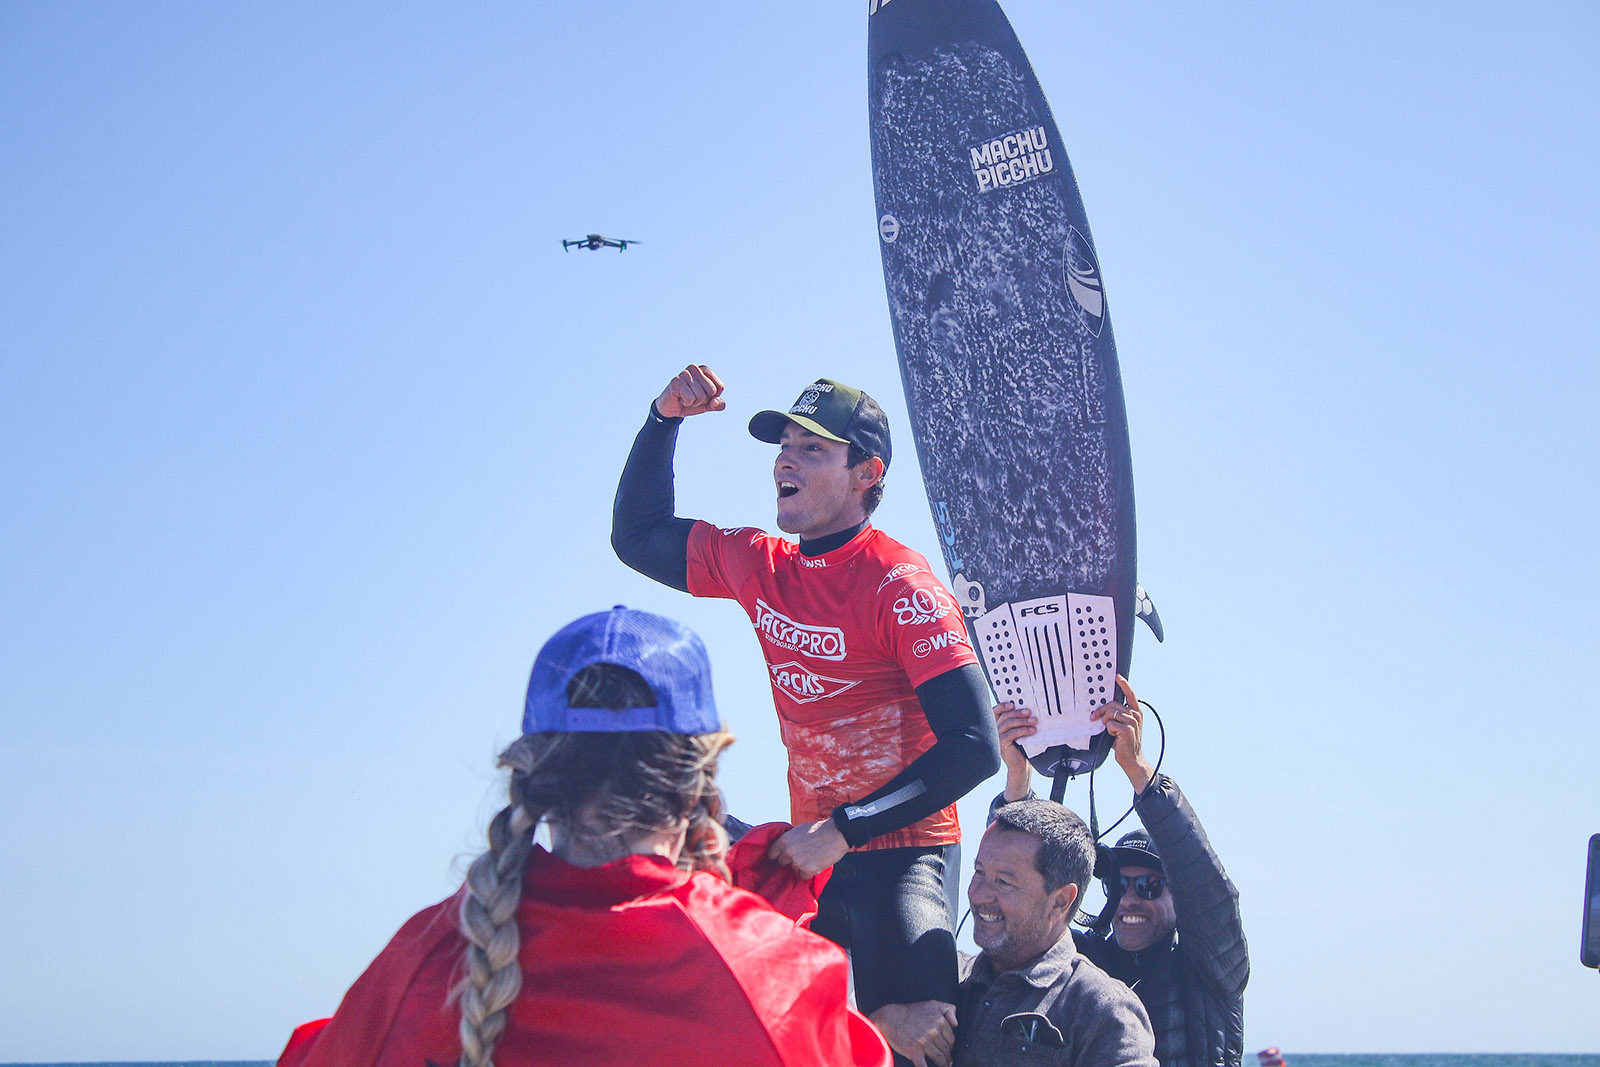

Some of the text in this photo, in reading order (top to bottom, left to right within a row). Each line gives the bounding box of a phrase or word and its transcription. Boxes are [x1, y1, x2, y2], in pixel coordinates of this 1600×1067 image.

[970, 126, 1048, 170] MACHU
[975, 149, 1053, 194] PICCHU
[934, 501, 964, 571] FCS
[892, 586, 953, 626] 805
[1020, 603, 1060, 618] FCS
